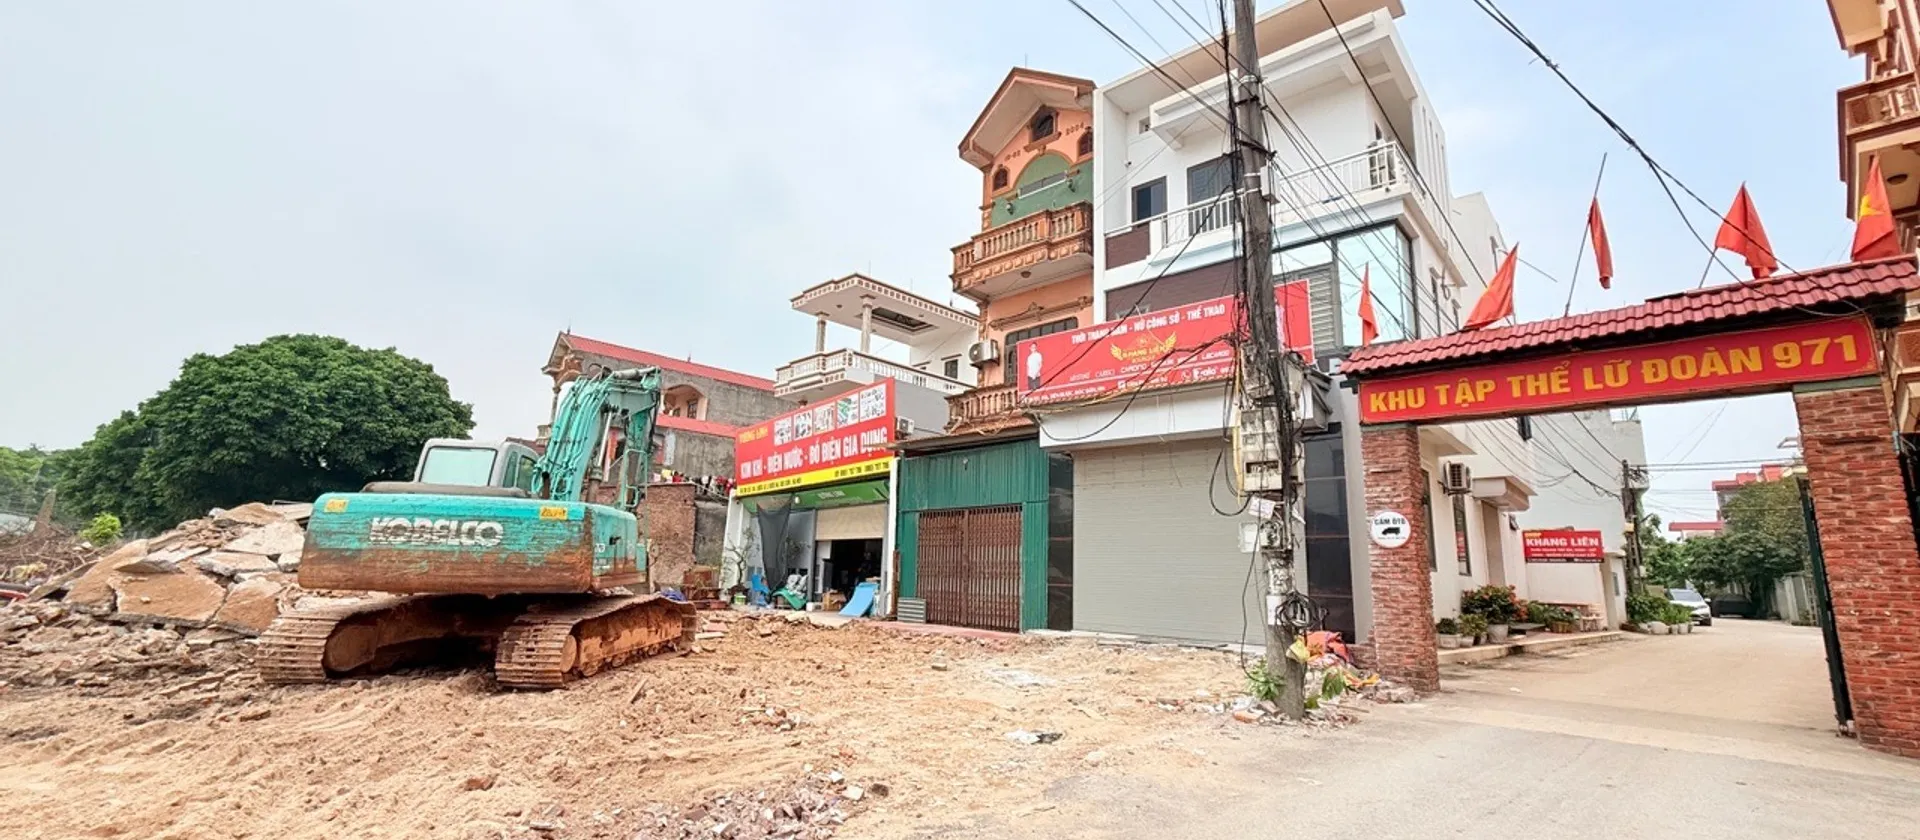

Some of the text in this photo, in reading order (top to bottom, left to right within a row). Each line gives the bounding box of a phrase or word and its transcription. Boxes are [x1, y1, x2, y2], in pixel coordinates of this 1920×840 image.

[1146, 315, 1168, 329] CÔNG
[1169, 310, 1180, 324] SỞ
[1203, 303, 1226, 318] THAO
[1370, 334, 1858, 413] KHU TẬP THỂ LỮ ĐOÀN 971
[783, 446, 804, 471] NƯỚC
[821, 436, 841, 465] ĐIỆN
[842, 434, 859, 458] GIA
[369, 516, 504, 547] KOBELCO
[1525, 536, 1599, 547] KHANG LIÊN
